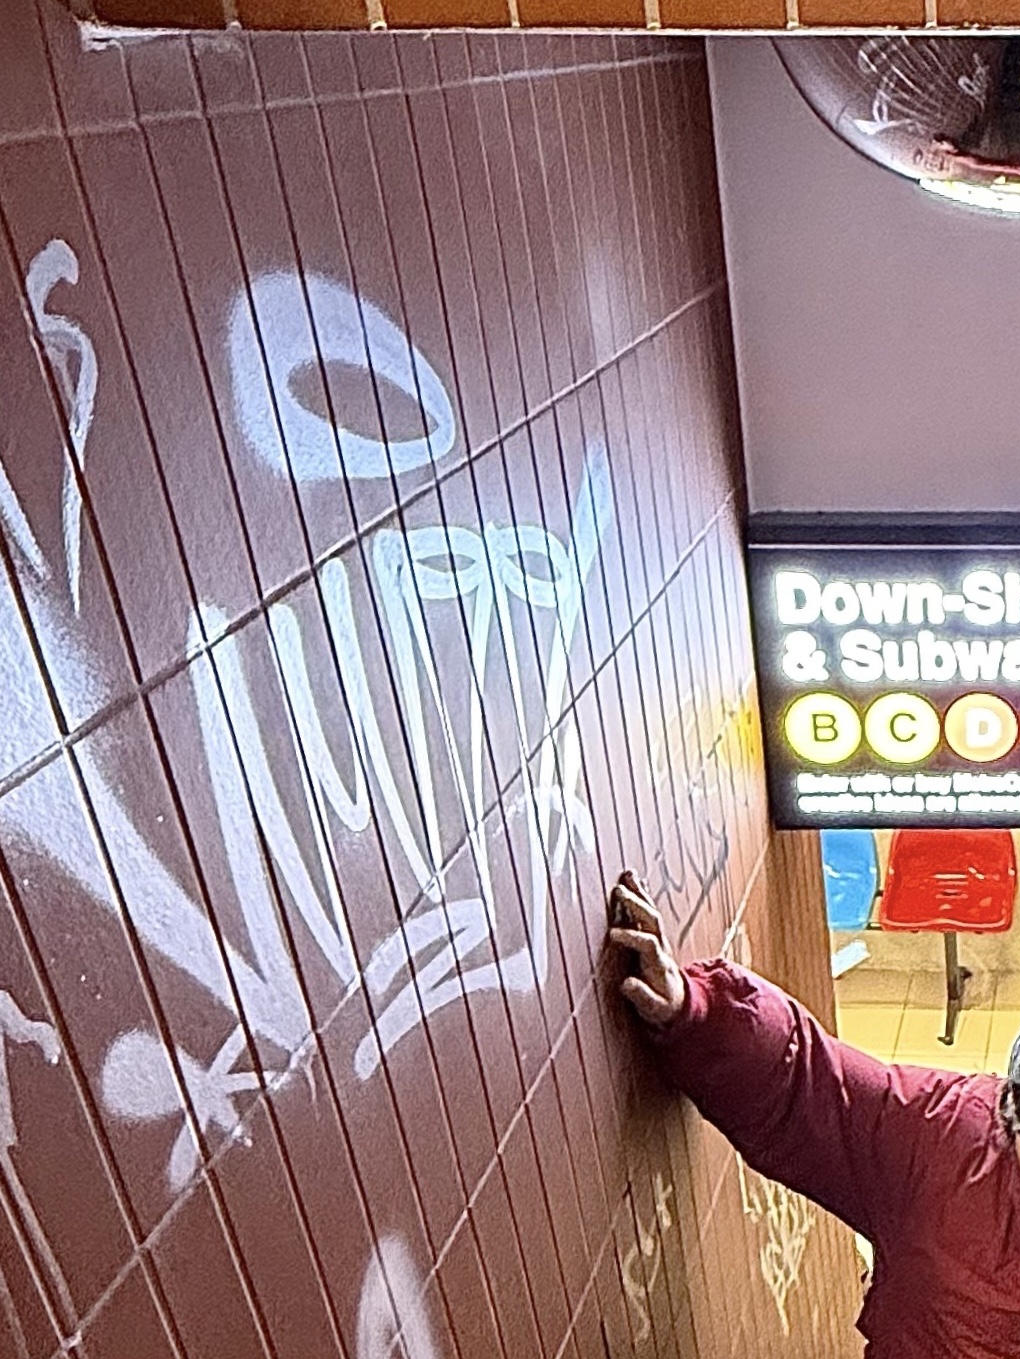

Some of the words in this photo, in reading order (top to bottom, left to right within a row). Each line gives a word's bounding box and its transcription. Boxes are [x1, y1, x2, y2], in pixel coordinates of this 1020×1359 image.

[781, 630, 829, 684] &
[811, 713, 839, 743] B
[890, 713, 917, 743] C
[965, 707, 1002, 748] D
